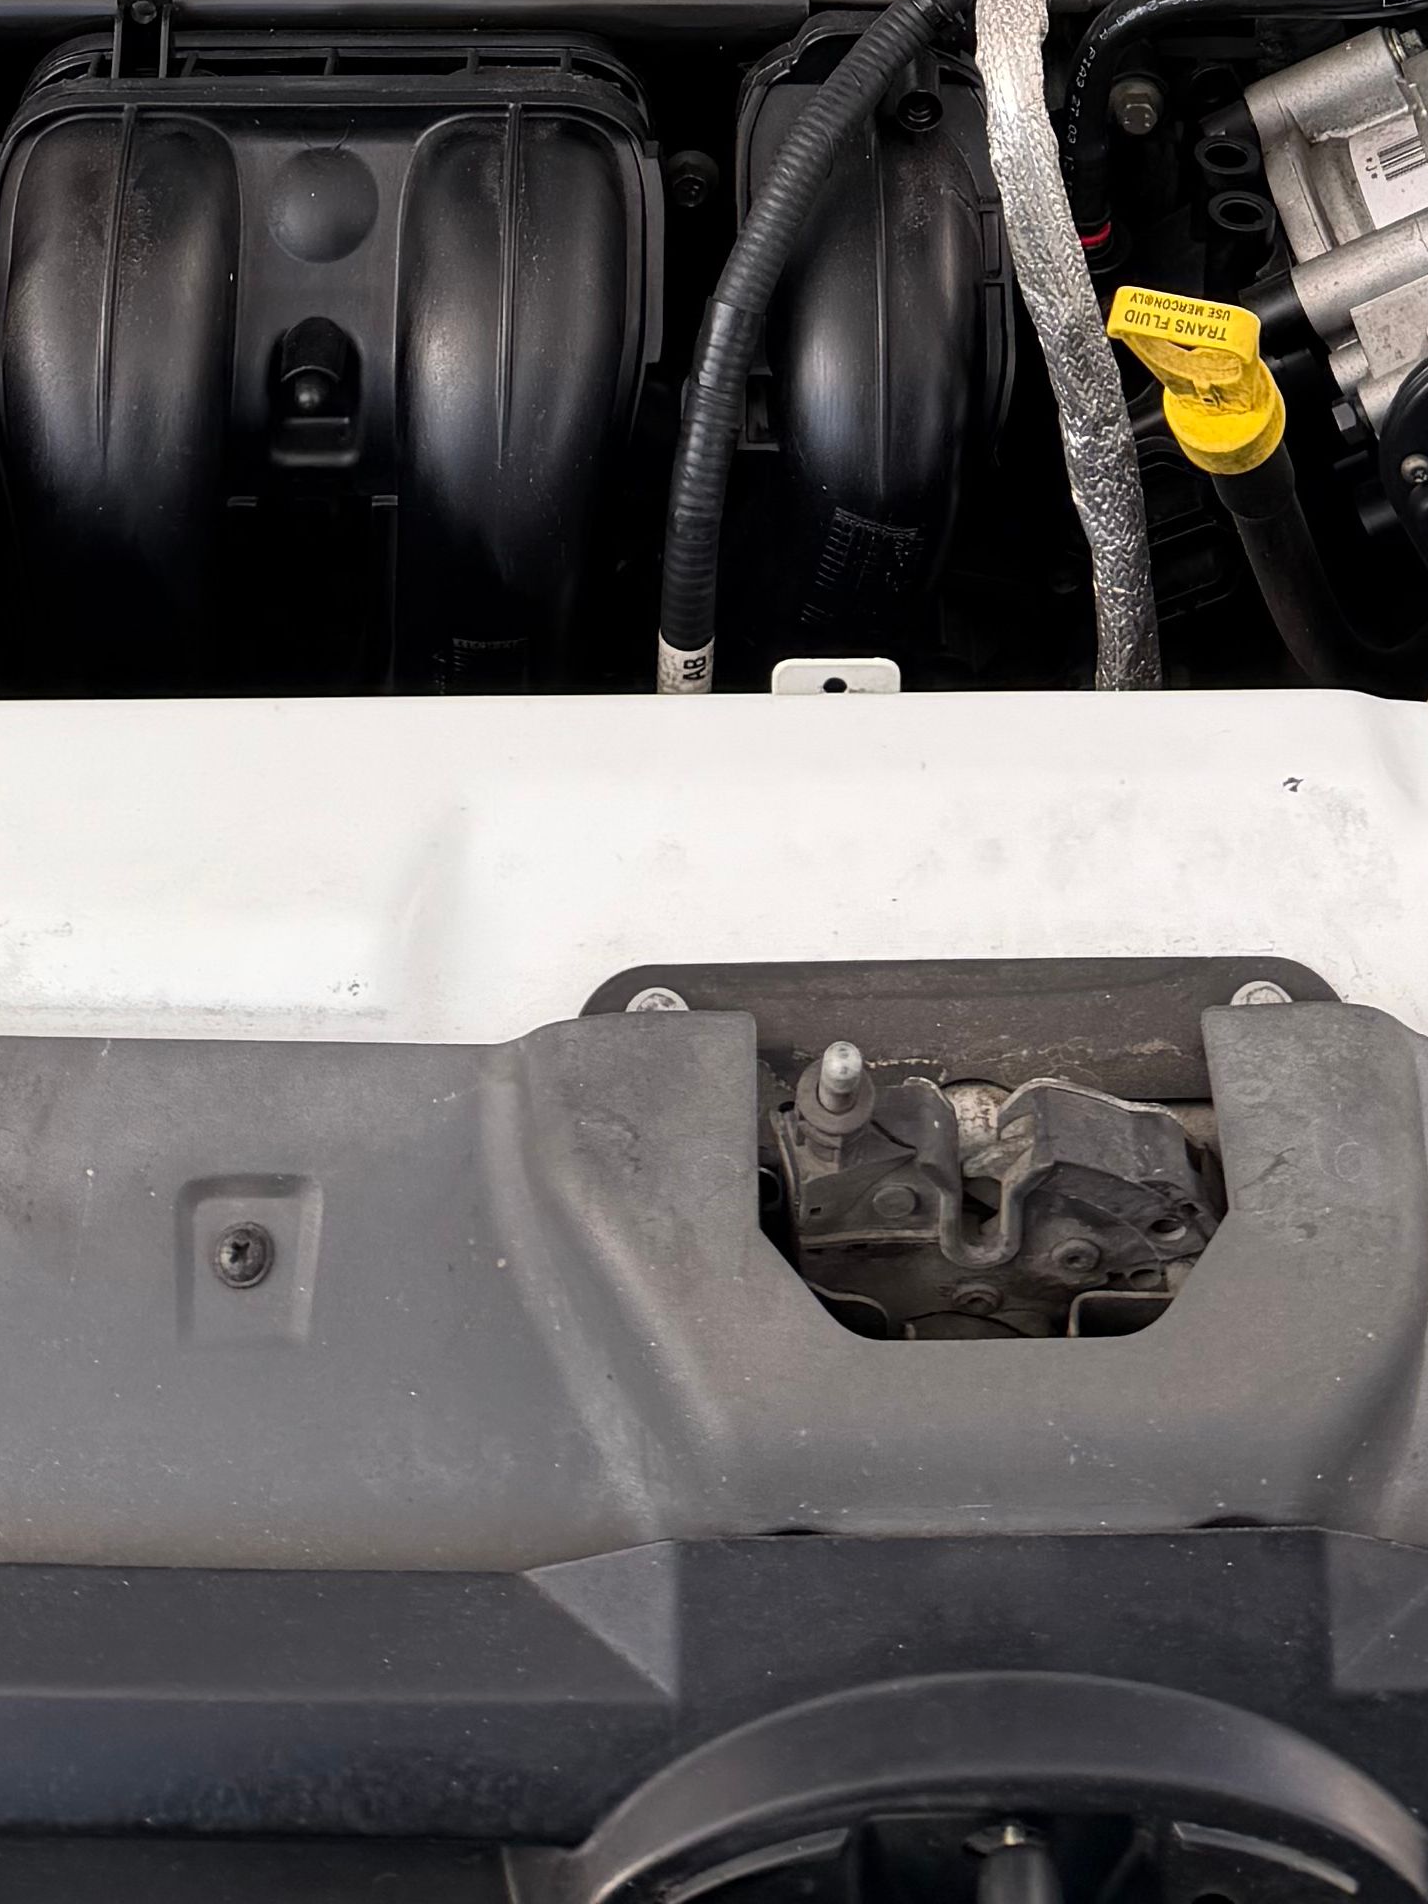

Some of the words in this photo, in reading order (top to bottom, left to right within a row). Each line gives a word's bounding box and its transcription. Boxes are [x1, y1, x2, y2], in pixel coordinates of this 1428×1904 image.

[1124, 309, 1171, 332] FLUID
[1207, 306, 1232, 321] USE
[1175, 318, 1228, 342] TRANS
[682, 655, 707, 681] AB
